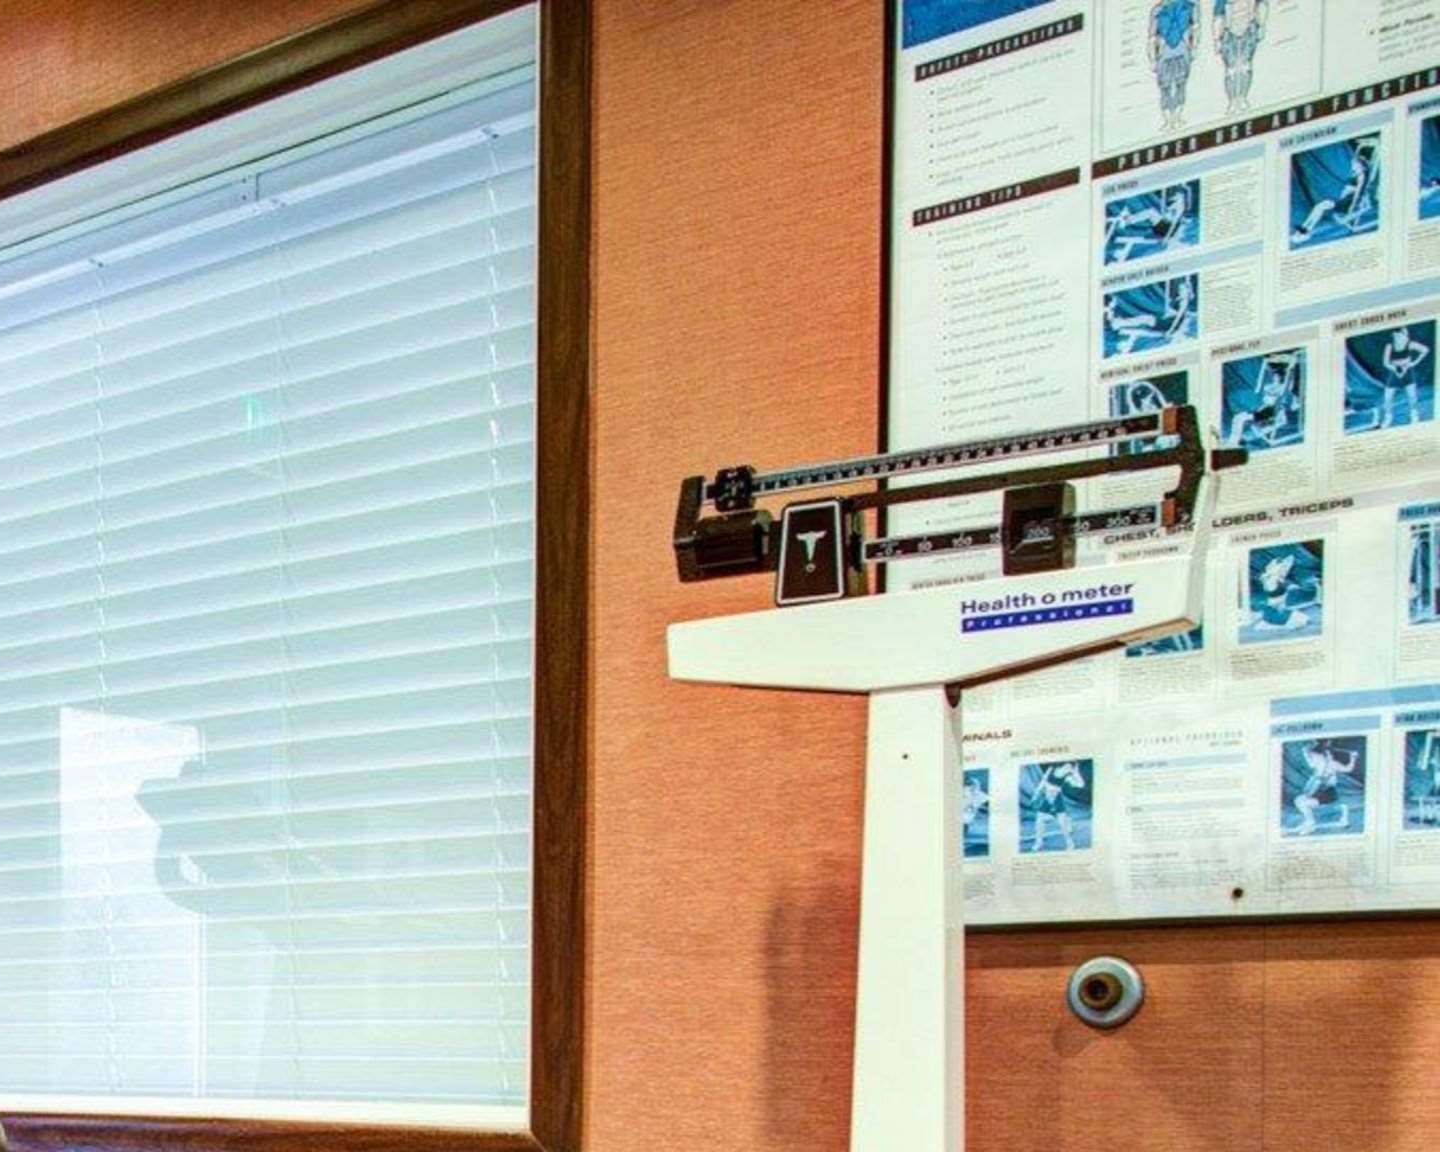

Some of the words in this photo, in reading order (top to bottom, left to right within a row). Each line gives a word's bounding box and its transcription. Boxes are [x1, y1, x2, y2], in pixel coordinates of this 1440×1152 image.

[1117, 137, 1198, 171] PROPER
[1215, 120, 1254, 145] USE
[1278, 497, 1355, 518] TRICEPS
[961, 592, 1036, 614] Health
[1061, 583, 1134, 604] meter
